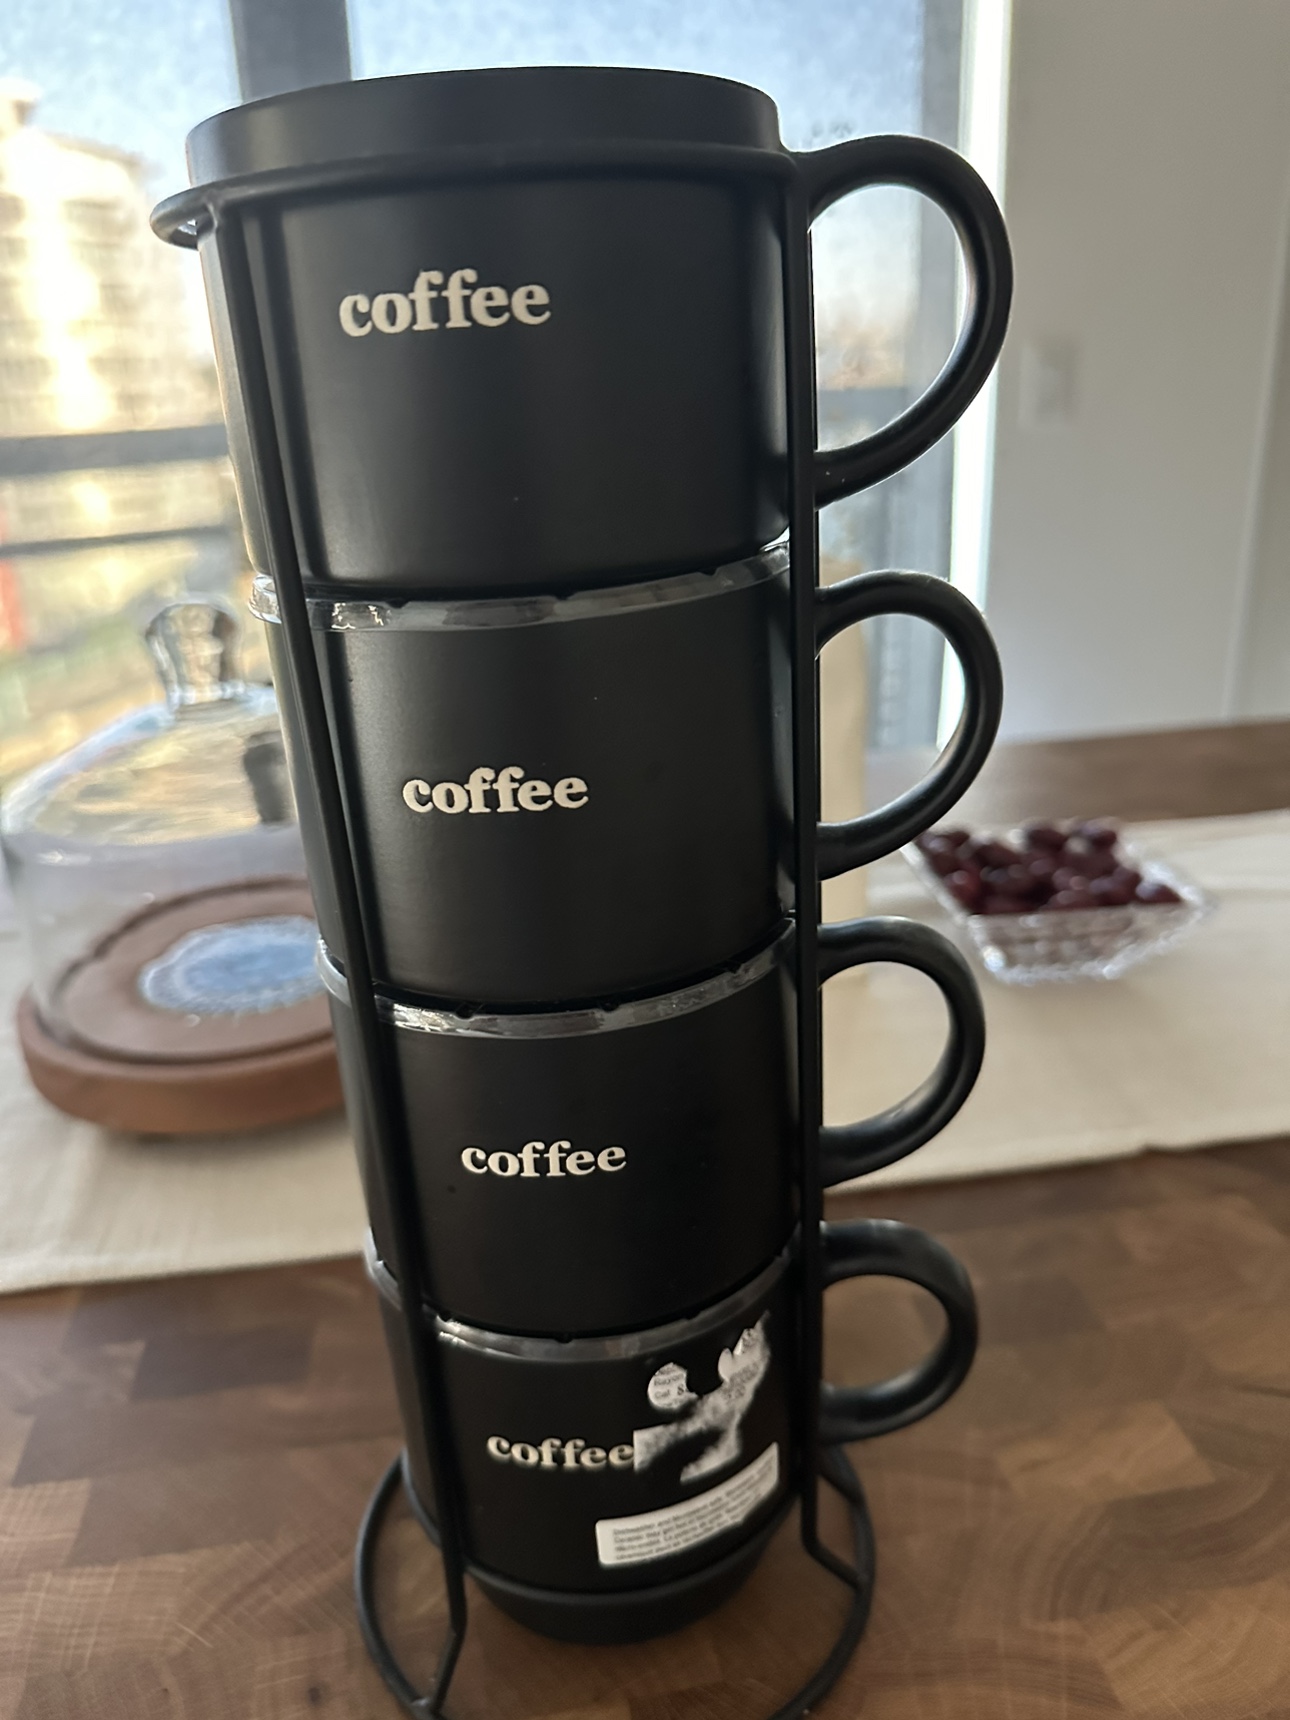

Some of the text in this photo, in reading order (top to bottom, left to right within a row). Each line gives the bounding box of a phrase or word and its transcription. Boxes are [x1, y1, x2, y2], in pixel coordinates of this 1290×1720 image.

[339, 268, 551, 337] coffee
[402, 766, 589, 814] coffee
[461, 1140, 627, 1177] coffee
[486, 1435, 635, 1468] coffee
